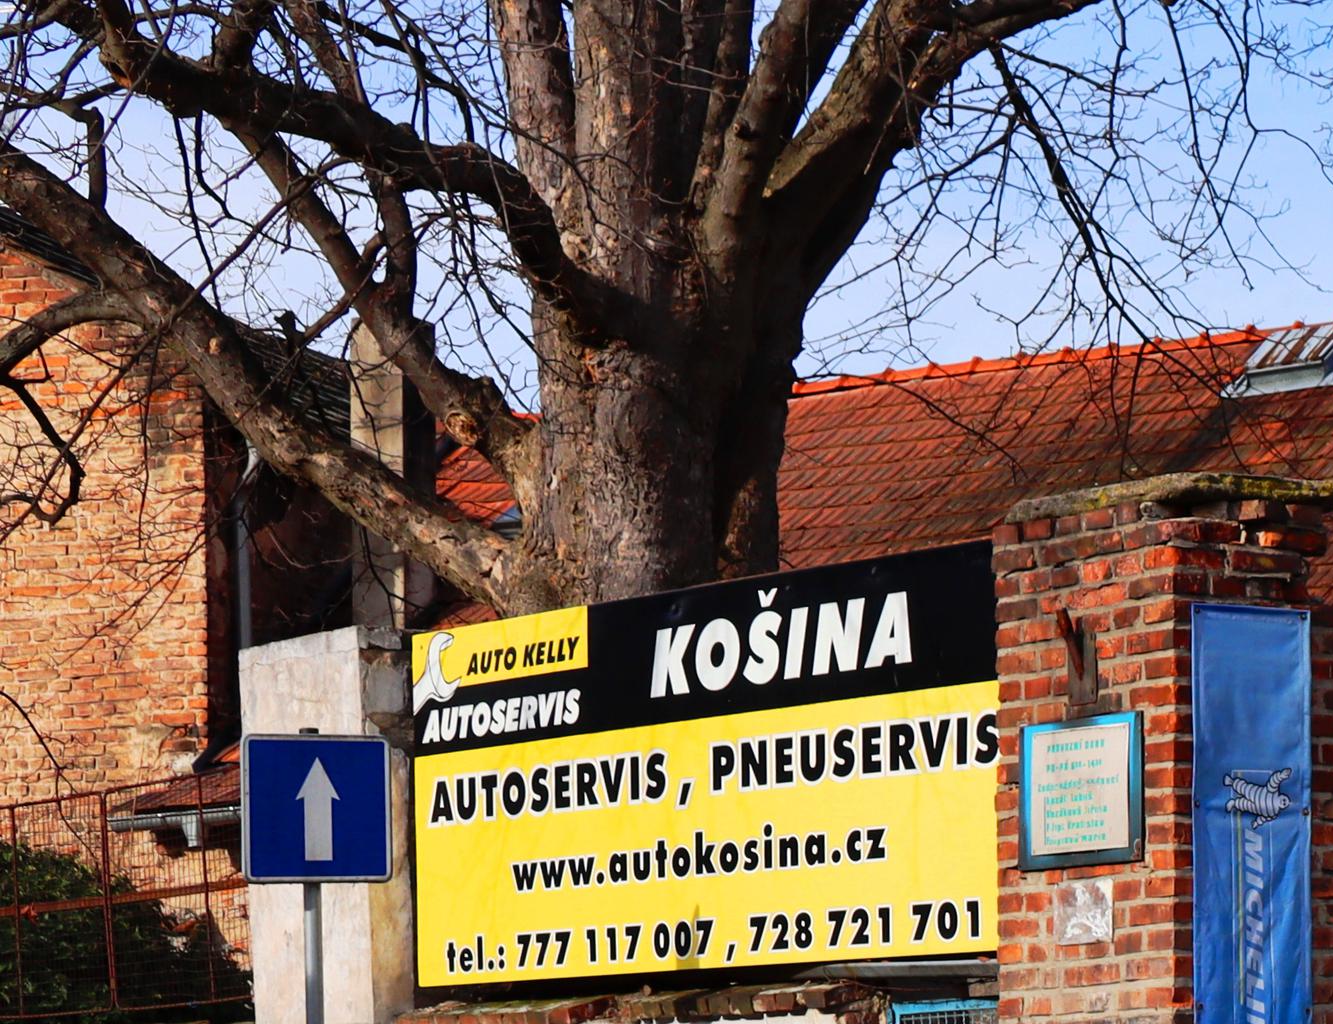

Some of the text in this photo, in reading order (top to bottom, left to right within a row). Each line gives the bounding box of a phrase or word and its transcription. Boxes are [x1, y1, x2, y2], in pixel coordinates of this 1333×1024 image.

[466, 636, 579, 676] AUTO KELLY
[650, 587, 913, 698] KOŠINA
[422, 688, 581, 744] AUTOSERVIS
[711, 712, 1000, 792] PNEUSERVIS
[512, 823, 887, 892] www.autokosina.cz
[446, 935, 506, 973] tel.:
[517, 930, 572, 967] 777
[585, 925, 642, 962] 117
[653, 919, 714, 959] 007
[749, 911, 813, 952] 728
[828, 907, 891, 947] 721
[911, 899, 980, 941] 701
